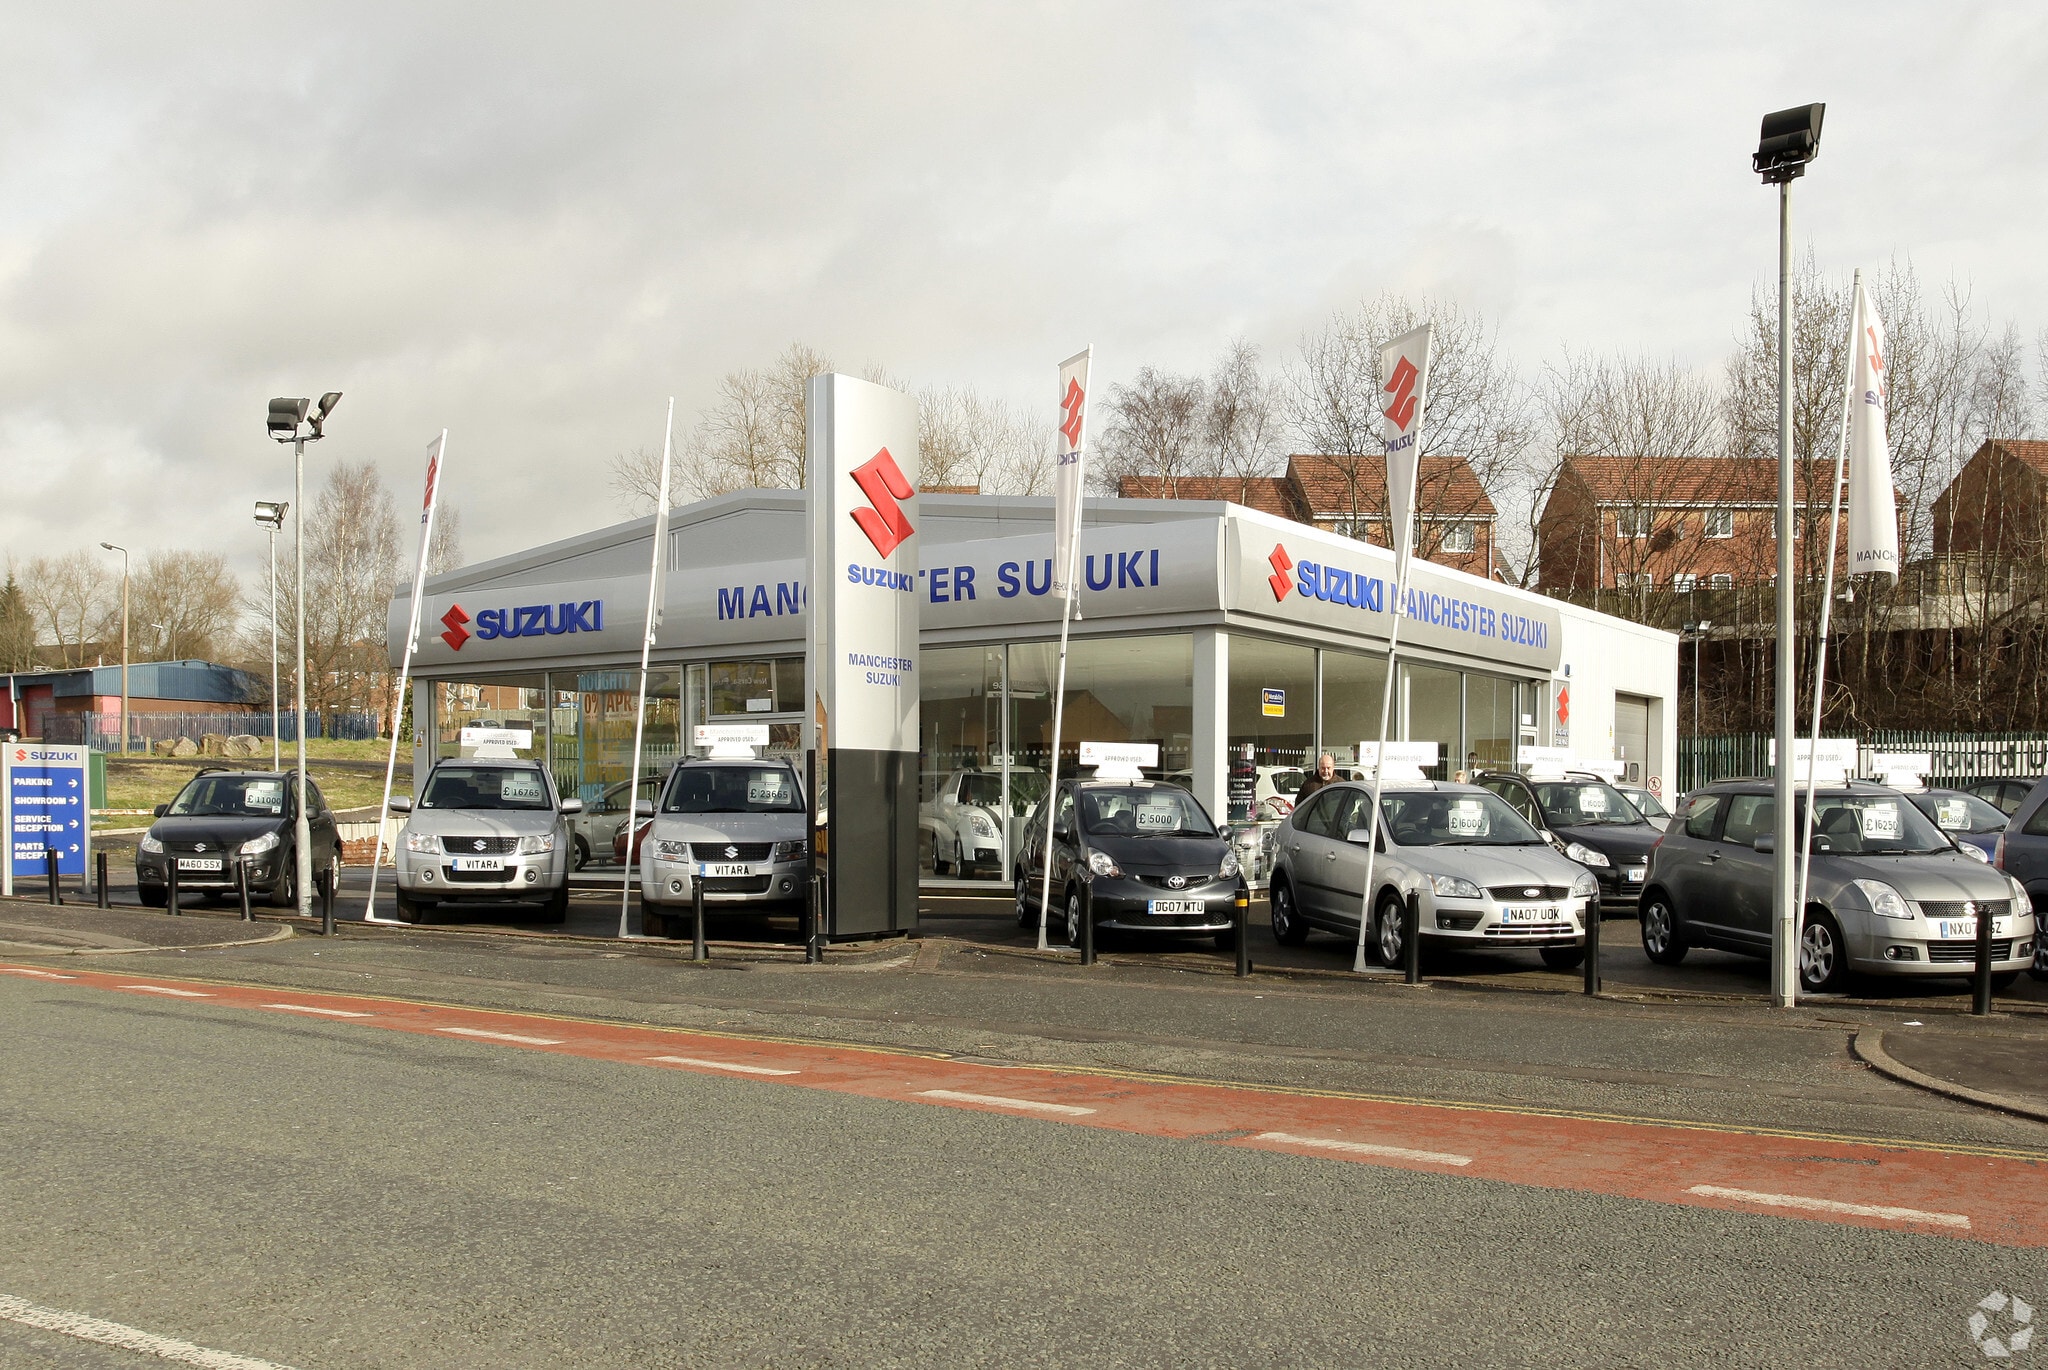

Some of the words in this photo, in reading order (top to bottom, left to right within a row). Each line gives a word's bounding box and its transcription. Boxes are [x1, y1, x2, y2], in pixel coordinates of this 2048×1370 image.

[847, 563, 914, 593] SUZUKI
[996, 548, 1160, 600] SUUKI
[1297, 559, 1384, 613] SUZUKI
[475, 598, 604, 641] SUZUKI
[1501, 611, 1548, 649] SUZUKI
[848, 652, 913, 672] MANCHESTER
[866, 671, 901, 687] SUZUKI
[606, 690, 633, 713] APR
[30, 751, 78, 761] SUZUKI
[13, 777, 53, 787] PARKING
[14, 796, 67, 805] SHOWROOM
[14, 815, 52, 824] SERVICE
[14, 824, 64, 833] RECEPTION
[14, 842, 45, 851] PARTS
[14, 851, 64, 860] RECEPTN
[179, 860, 202, 869] MA60
[203, 860, 221, 869] SSX
[466, 860, 499, 870] VITARA
[715, 865, 750, 876] VITARA
[1155, 901, 1182, 912] DG07
[1510, 908, 1538, 920] NA07
